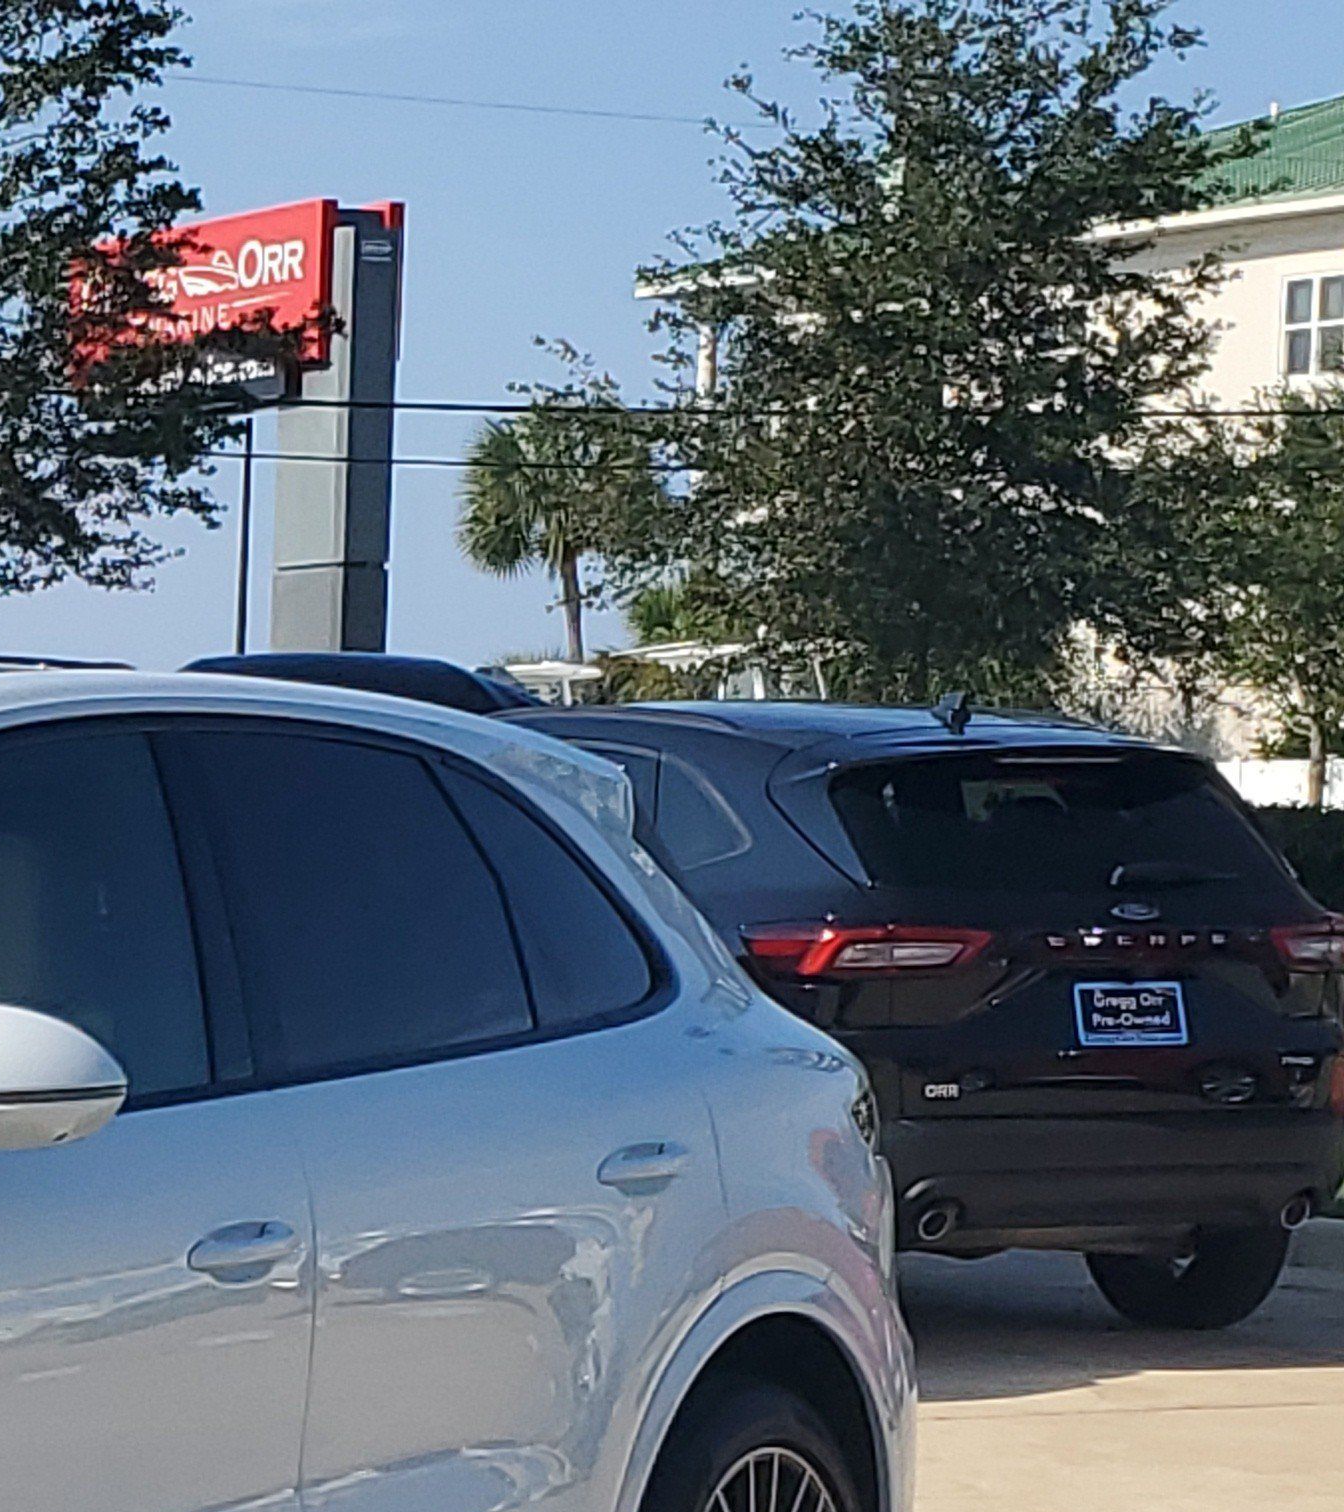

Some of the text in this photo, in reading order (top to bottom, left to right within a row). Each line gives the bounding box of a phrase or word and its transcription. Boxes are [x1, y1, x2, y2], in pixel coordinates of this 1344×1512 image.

[237, 240, 305, 288] ORR
[1093, 992, 1165, 1010] Gregg Orr
[1092, 1010, 1171, 1028] Pre-Owned
[924, 1084, 960, 1098] ORR
